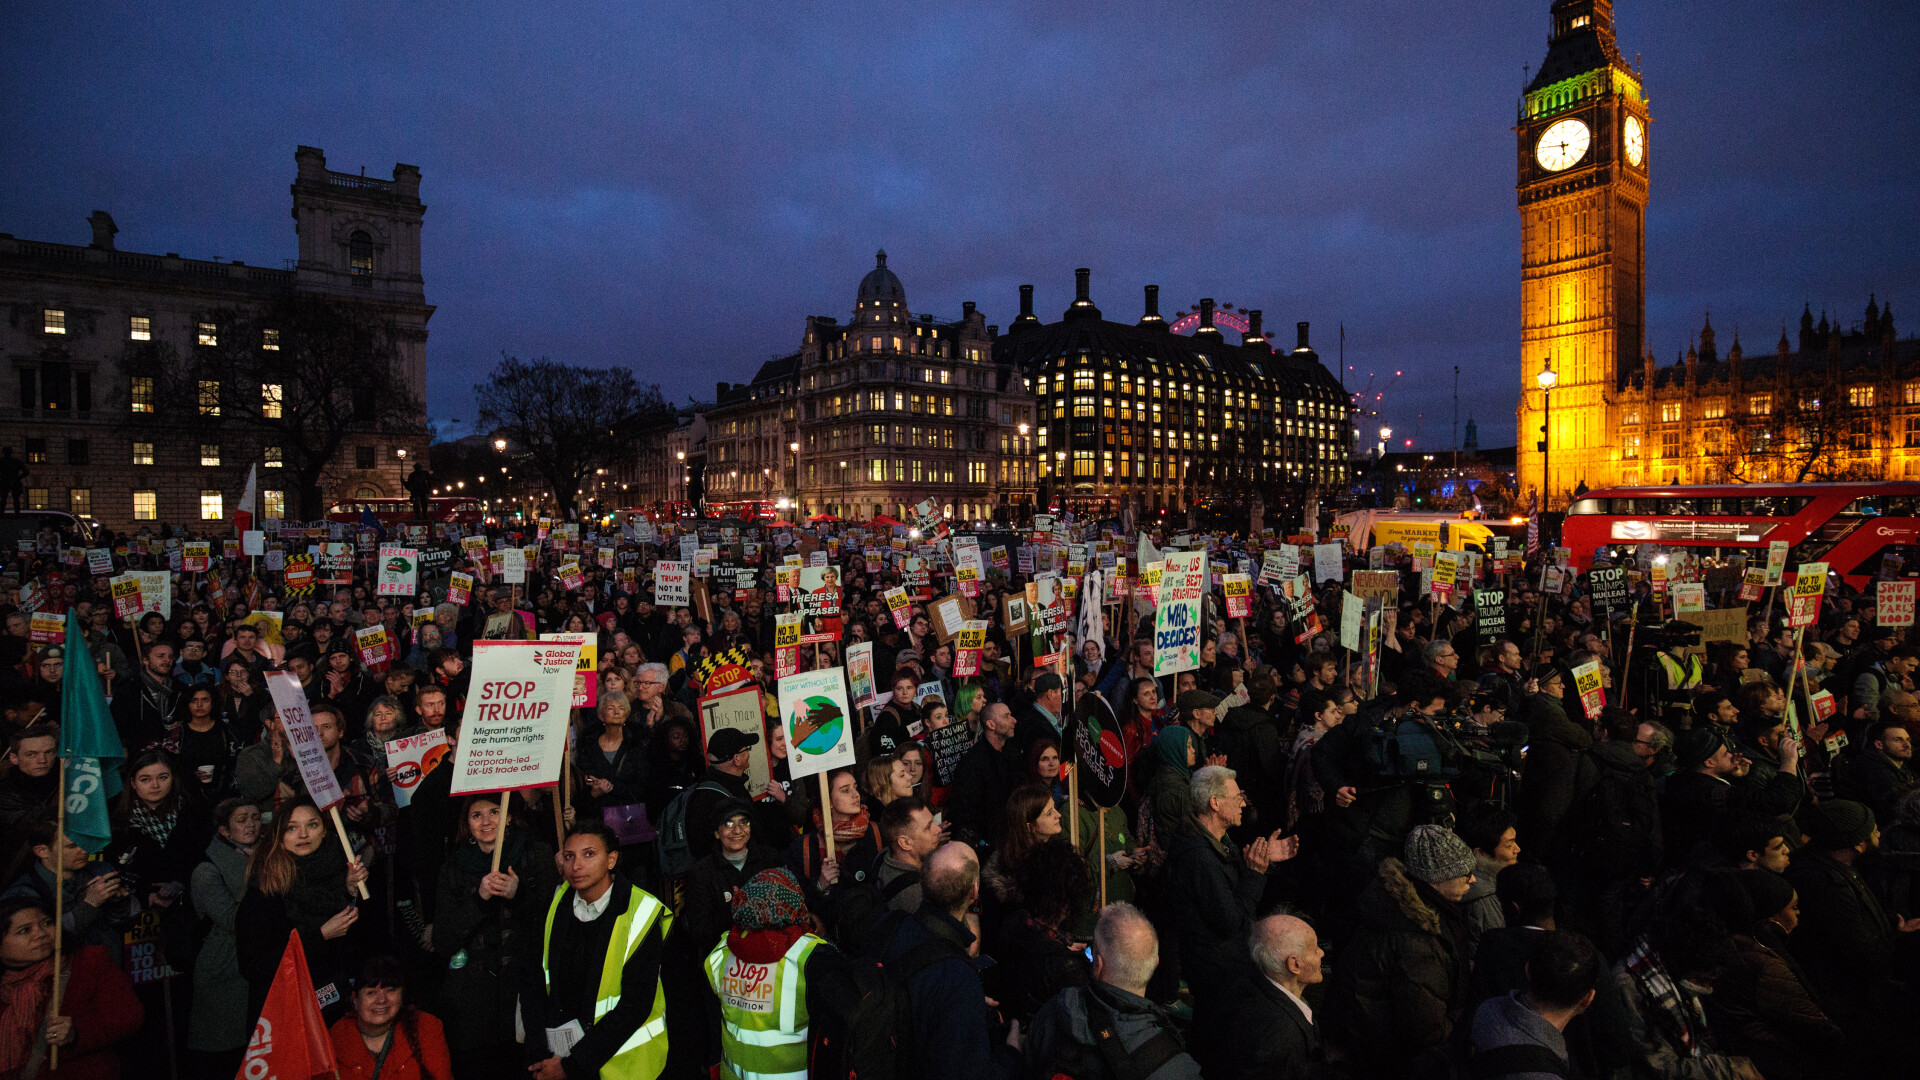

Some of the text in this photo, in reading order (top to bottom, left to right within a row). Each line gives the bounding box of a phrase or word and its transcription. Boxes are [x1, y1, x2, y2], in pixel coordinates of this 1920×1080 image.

[1877, 527, 1894, 536] Go
[381, 549, 418, 557] RECLAIM
[418, 550, 451, 562] Trump
[660, 563, 688, 572] MAY THE
[1190, 557, 1200, 571] US
[1354, 572, 1397, 588] NEVER AGAIN
[1590, 568, 1623, 582] STOP
[1800, 577, 1808, 585] NO
[380, 584, 412, 593] PEPE
[736, 580, 756, 589] TRUMP
[1797, 584, 1821, 594] RACISM
[1878, 583, 1911, 594] SHUT
[115, 586, 137, 596] RACISM
[791, 592, 839, 602] THERESA
[116, 598, 125, 606] NO
[890, 599, 908, 609] RACISM
[1290, 593, 1313, 609] THERESA
[1478, 591, 1504, 606] STOP
[1794, 598, 1805, 606] NO
[1880, 595, 1912, 603] DOWN
[118, 606, 140, 616] TRUMP
[1031, 606, 1065, 620] THERESA
[1167, 603, 1187, 628] WHO
[1292, 605, 1314, 621] APPEASER
[1480, 617, 1505, 626] NUCLEAR
[1792, 614, 1814, 625] TRUMP
[1880, 615, 1911, 623] WOOD
[777, 627, 786, 636] NO
[1033, 621, 1066, 636] APPEASER
[361, 638, 384, 648] RACISM
[777, 634, 797, 645] RACISM
[960, 639, 982, 648] RACISM
[1157, 625, 1200, 650] DECIDES?
[777, 648, 786, 658] NO
[365, 655, 387, 665] TRUMP
[957, 658, 965, 666] TO
[776, 666, 796, 678] TRUMP
[955, 666, 976, 676] TRUMP
[712, 668, 741, 688] STOP
[800, 678, 828, 689] WITHOUT
[481, 681, 536, 700] STOP
[1580, 680, 1599, 693] RACISM
[283, 707, 304, 725] STOP
[478, 702, 549, 721] TRUMP
[703, 702, 730, 729] This
[734, 708, 755, 723] man
[290, 726, 314, 744] TRUMP
[473, 726, 532, 736] Migrant rights
[940, 728, 952, 738] YOU
[953, 721, 967, 733] WANT
[1078, 719, 1089, 739] THE
[490, 736, 520, 744] human
[931, 740, 940, 750] TO
[1100, 737, 1124, 759] AUSTERITY
[468, 756, 530, 766] corporate-led
[467, 763, 539, 775] UK-US trade deal
[1083, 752, 1111, 788] ASSEMBLY
[131, 943, 155, 957] NO
[131, 955, 153, 970] TO
[131, 964, 178, 982] TRUM
[729, 958, 768, 992] Stop
[722, 977, 772, 999] TRUMP
[318, 990, 337, 1004] ERE
[727, 998, 764, 1010] COALITION
[245, 1016, 277, 1080] Glo
